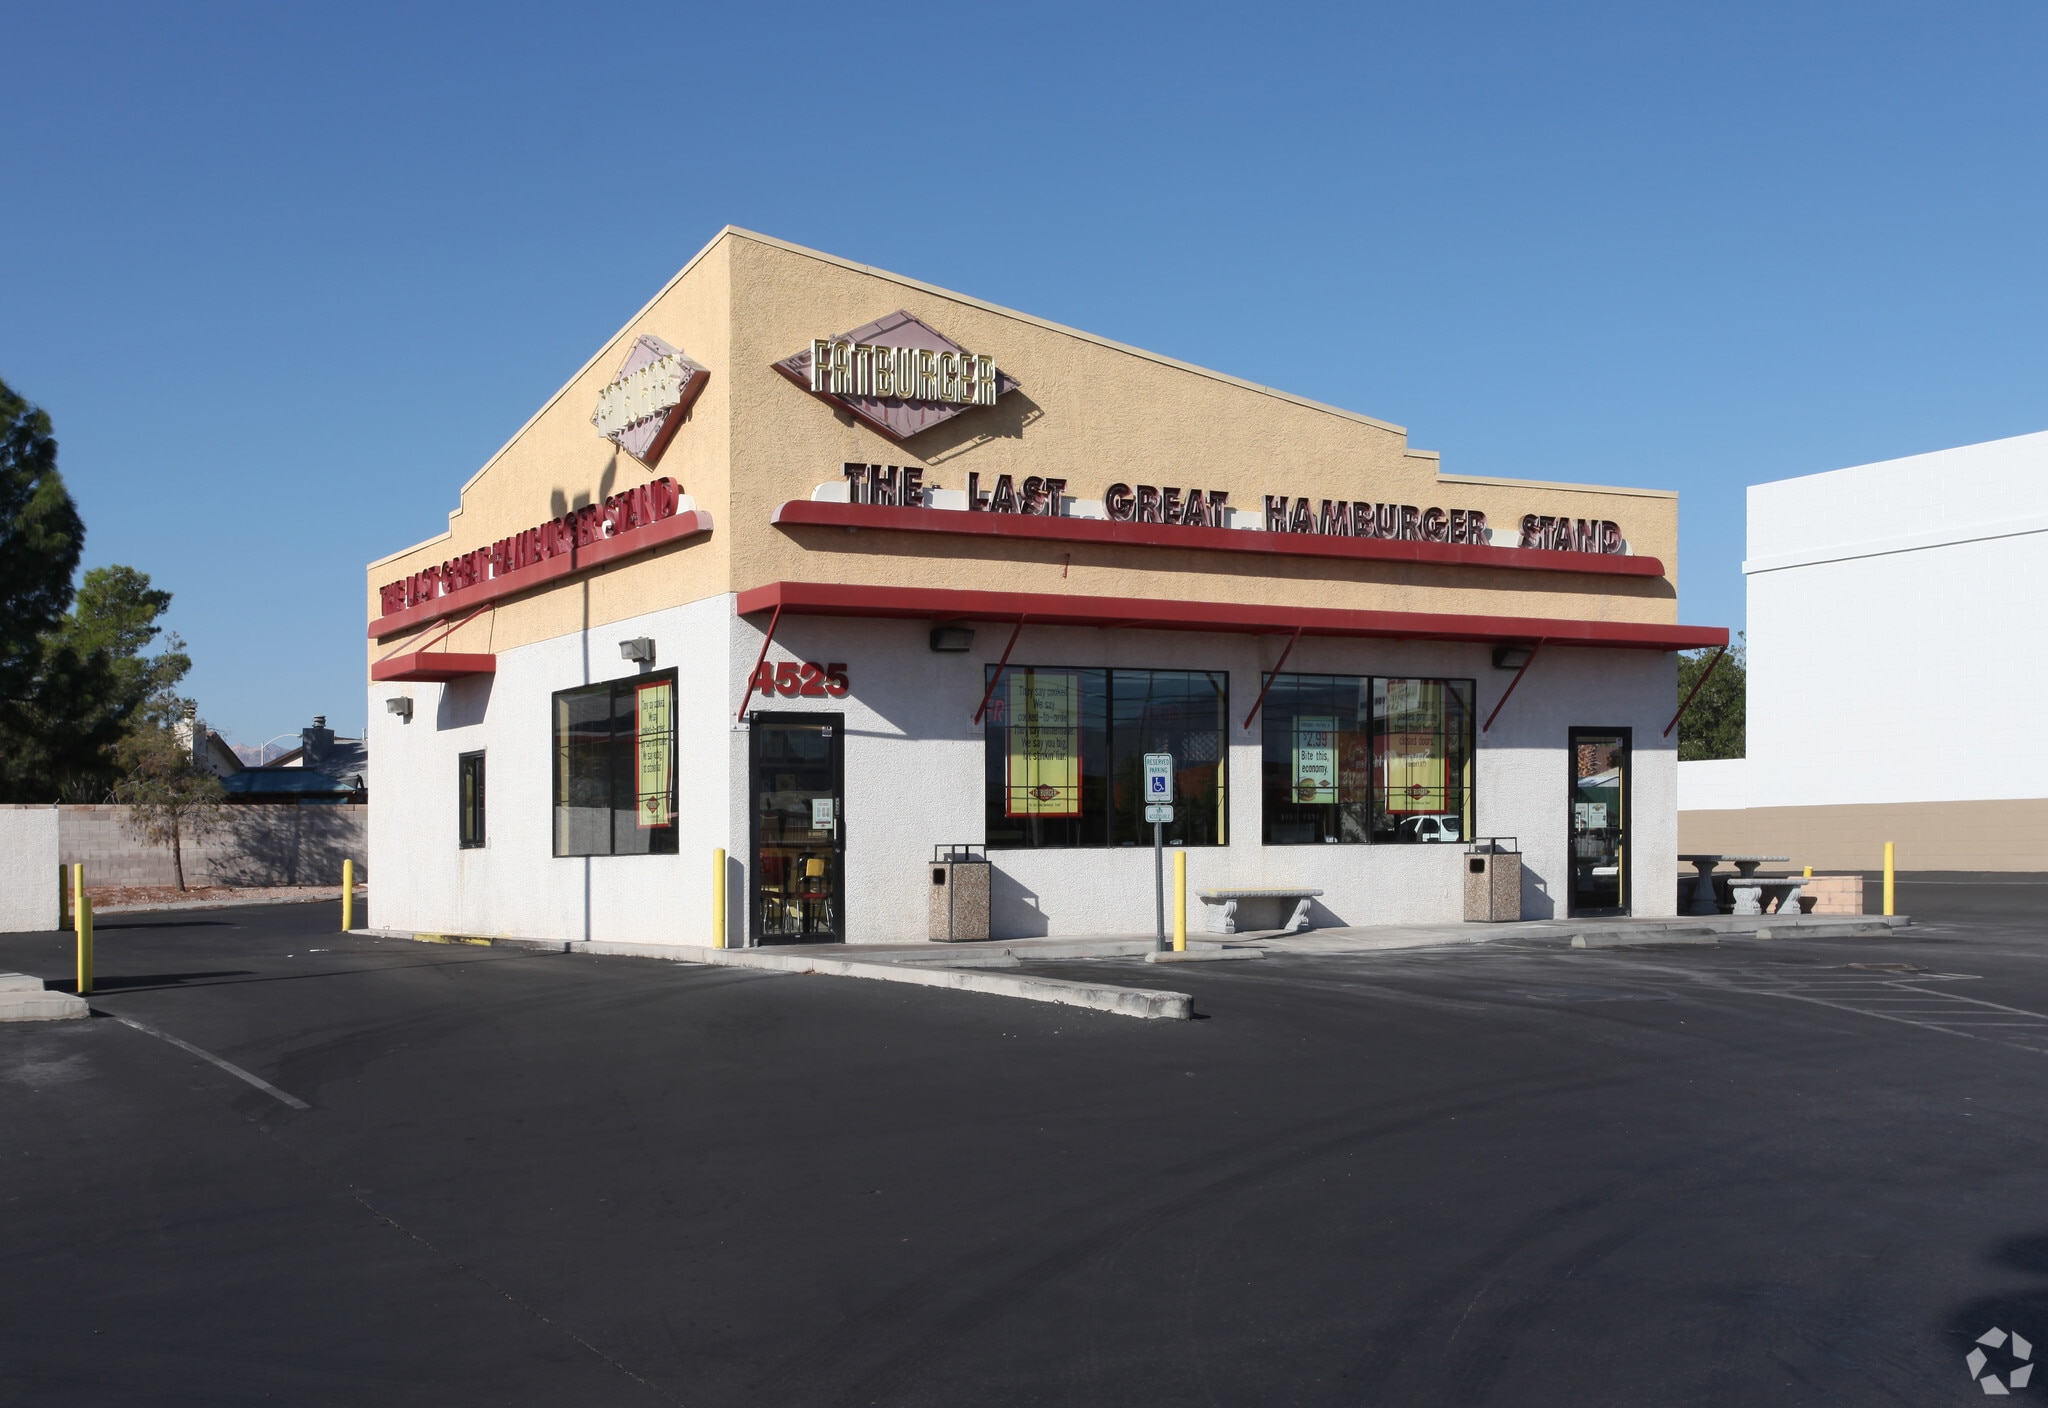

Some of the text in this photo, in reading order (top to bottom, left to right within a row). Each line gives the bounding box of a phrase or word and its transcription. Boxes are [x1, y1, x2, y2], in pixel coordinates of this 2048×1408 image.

[811, 338, 997, 405] FATBURGER
[604, 477, 680, 535] STAND
[841, 462, 1624, 555] THE LAST GREAT HAMBURGER STAND
[748, 661, 850, 697] 4525
[1146, 758, 1170, 766] RESERVED
[1301, 750, 1314, 761] Bite
[1301, 764, 1329, 776] economy.
